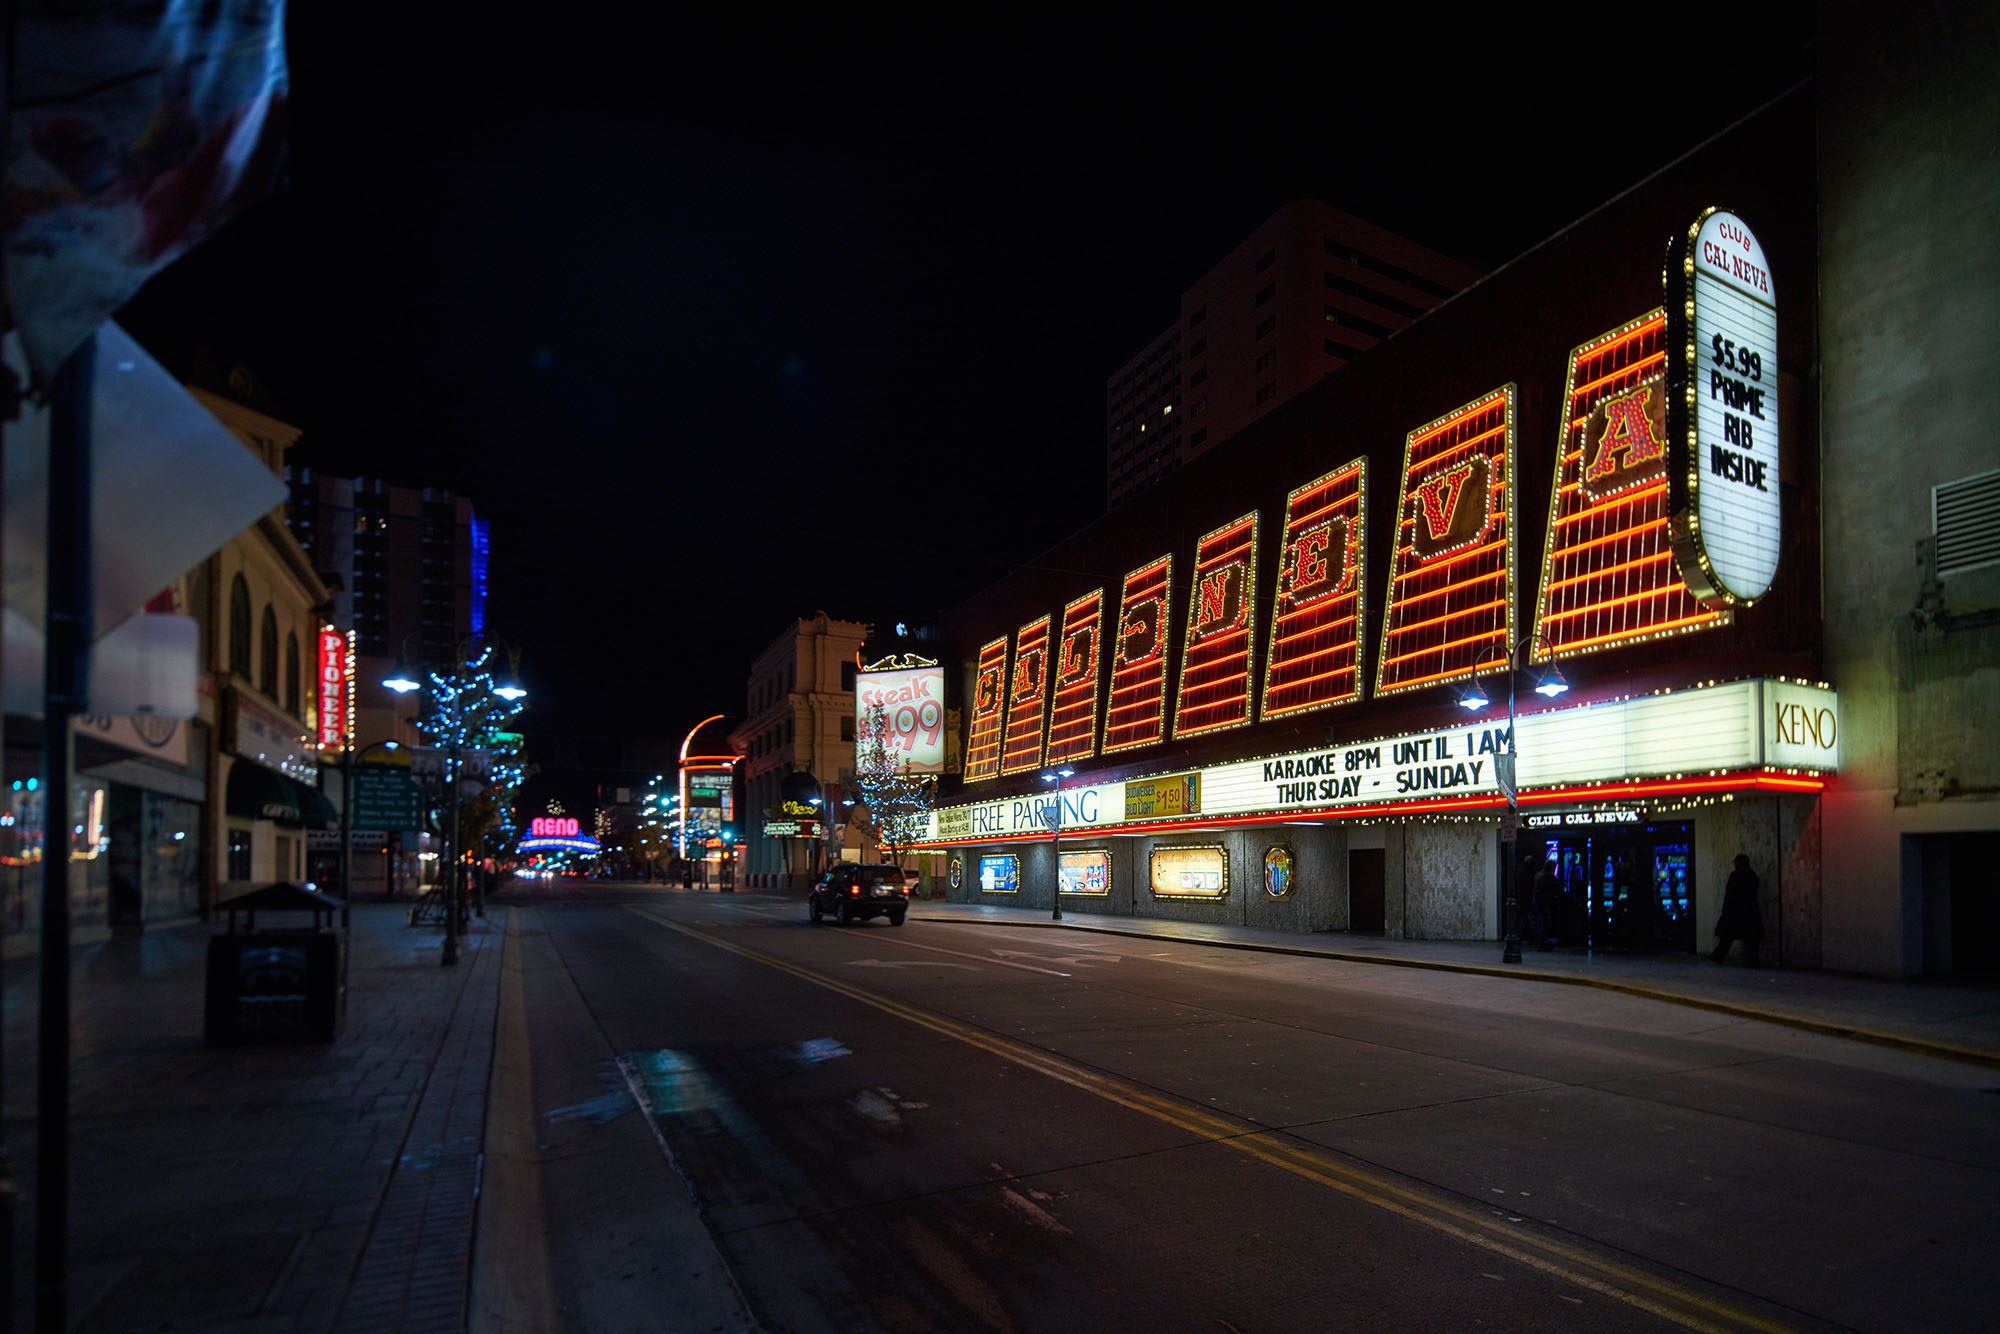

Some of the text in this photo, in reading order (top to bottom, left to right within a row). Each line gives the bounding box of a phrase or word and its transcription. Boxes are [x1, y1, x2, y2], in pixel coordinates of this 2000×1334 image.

[1718, 221, 1751, 252] CLUB
[1703, 239, 1769, 295] CAL NEVA
[1711, 332, 1762, 382] $5.99
[1710, 369, 1766, 421] PRIME
[1723, 411, 1754, 450] RIB
[1710, 443, 1768, 493] INSIDE
[322, 634, 343, 745] PIONEER
[861, 676, 931, 712] Steak
[1775, 701, 1837, 751] KENO
[1263, 752, 1336, 782] KARAOKE
[1344, 746, 1381, 772] 8PM
[1393, 736, 1454, 766] UNTIL
[1477, 726, 1512, 755] AM
[1126, 784, 1155, 799] BUDWEISER
[1276, 775, 1363, 804] THURSDAY
[1396, 760, 1485, 794] SUNDAY
[531, 816, 579, 837] RENO
[971, 803, 1005, 833] FREE
[1126, 801, 1155, 817] BUD LIGHT
[1527, 810, 1639, 826] CLUB CAL NEVA
